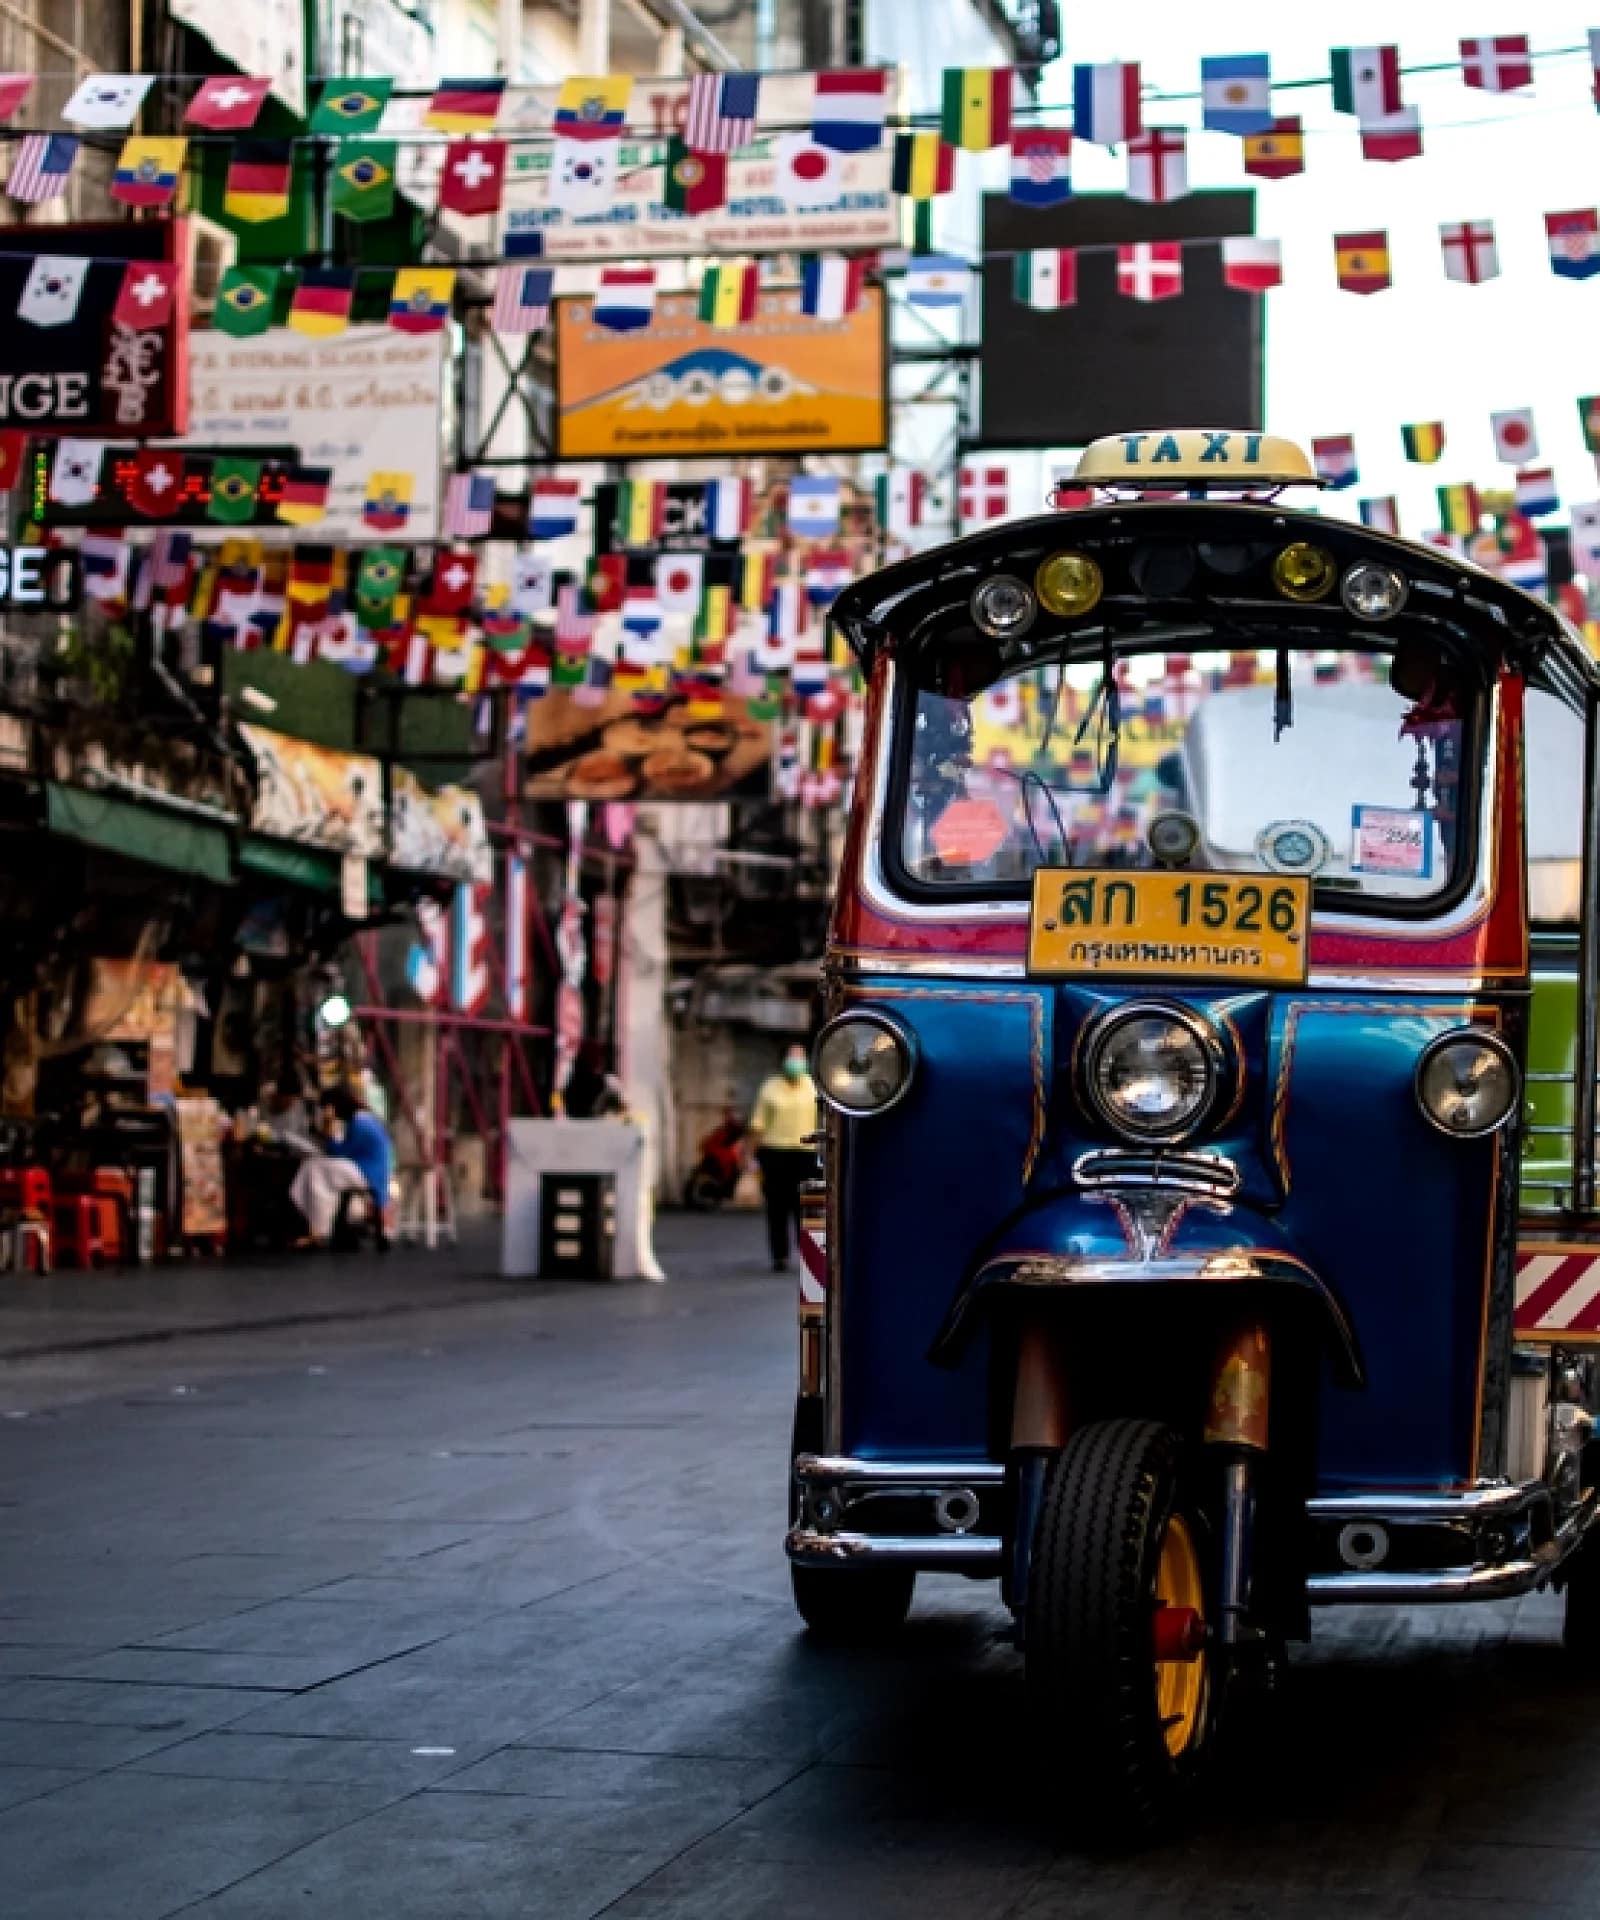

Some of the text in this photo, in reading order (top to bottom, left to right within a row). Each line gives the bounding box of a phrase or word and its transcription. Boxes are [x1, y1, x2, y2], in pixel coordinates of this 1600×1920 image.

[1119, 432, 1263, 464] TAXI
[0, 546, 47, 602] E
[1061, 877, 1296, 932] สก 1526
[1070, 941, 1261, 968] กรุงเทพมหานคร
